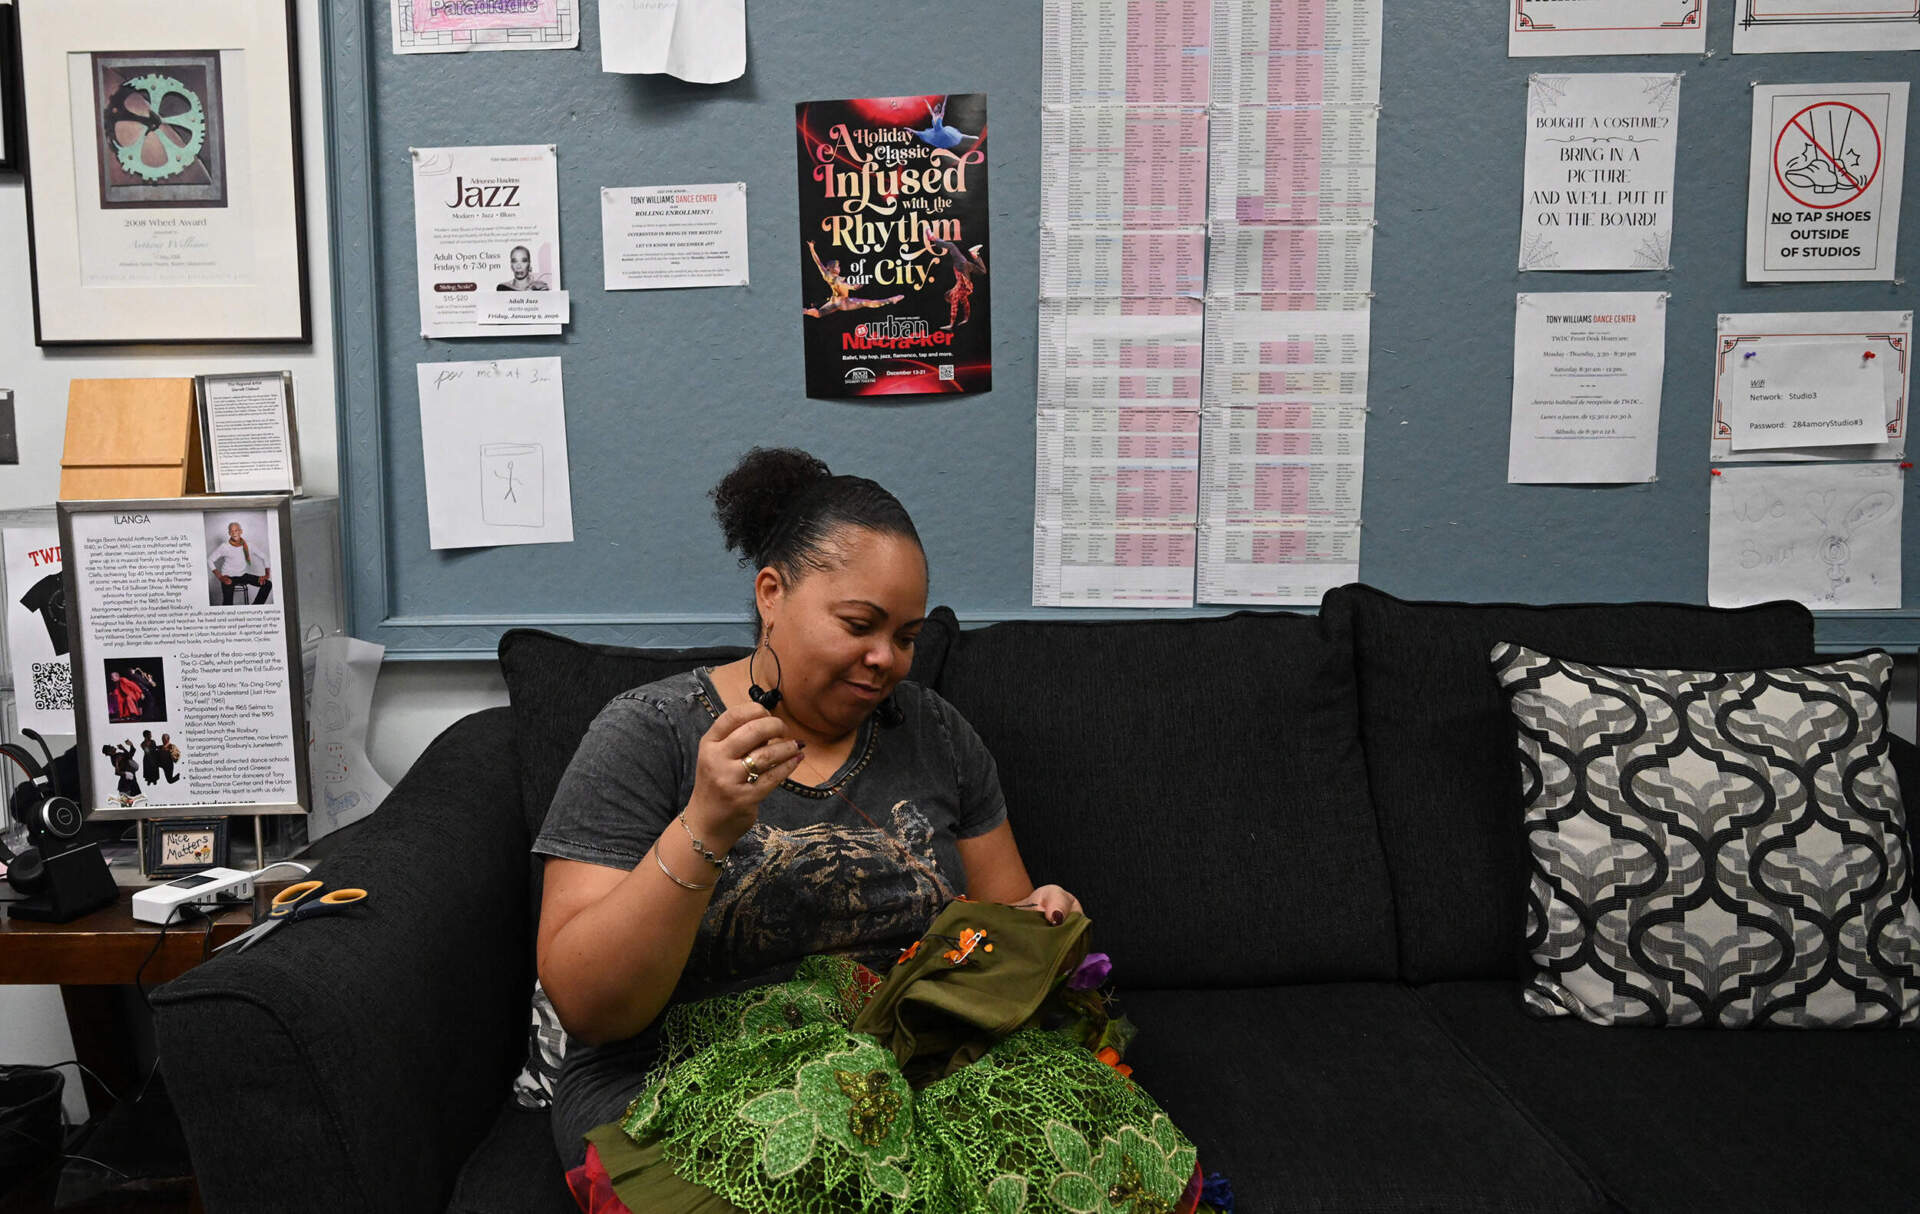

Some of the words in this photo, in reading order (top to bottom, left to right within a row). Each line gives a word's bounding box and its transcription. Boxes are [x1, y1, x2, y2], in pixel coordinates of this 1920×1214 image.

[1536, 117, 1585, 128] BOUGHT
[1593, 117, 1599, 128] A
[1603, 117, 1669, 128] COSTUME?
[816, 124, 874, 163] A
[853, 128, 914, 147] Holiday
[874, 145, 930, 168] Classic
[1560, 148, 1604, 161] BRING
[1610, 148, 1623, 161] IN
[1629, 148, 1640, 161] A
[813, 148, 985, 215] Infused
[1568, 170, 1631, 183] PICTURE
[445, 177, 520, 208] Jazz
[1530, 191, 1560, 205] AND
[1618, 191, 1648, 204] PUT
[1654, 191, 1668, 204] IT
[630, 196, 645, 205] TONY
[646, 195, 674, 204] WILLIAMS
[675, 195, 695, 203] DANCE
[695, 194, 717, 202] CENTER
[902, 197, 929, 210] with
[933, 197, 952, 214] the
[149, 219, 176, 227] Wheel
[179, 218, 207, 226] Award
[1538, 213, 1560, 226] ON
[1568, 213, 1596, 226] THE
[1600, 213, 1656, 226] BOARD!
[1771, 212, 1793, 223] NO
[1796, 212, 1822, 222] TAP
[1826, 211, 1871, 222] SHOES
[821, 211, 962, 260] Rhythm
[1791, 229, 1849, 239] OUTSIDE
[434, 253, 453, 261] Adult
[456, 253, 477, 262] Open
[479, 252, 501, 260] Class
[1781, 248, 1799, 257] OF
[1802, 247, 1861, 257] STUDIOS
[489, 263, 501, 271] pm
[850, 259, 867, 275] of
[847, 274, 873, 286] our
[874, 258, 940, 291] City.
[1546, 315, 1561, 323] TONY
[1563, 315, 1592, 323] WILLIAMS
[1593, 315, 1612, 323] DANCE
[1614, 315, 1636, 323] CENTER
[865, 315, 929, 339] urban
[842, 329, 955, 350] Nutcracker
[1750, 379, 1766, 388] Wifi
[1750, 393, 1783, 401] Network:
[1792, 419, 1863, 429] 284amoryStudio#3
[114, 514, 151, 524] ILANGA
[167, 832, 190, 846] Nice
[166, 834, 208, 861] Matters
